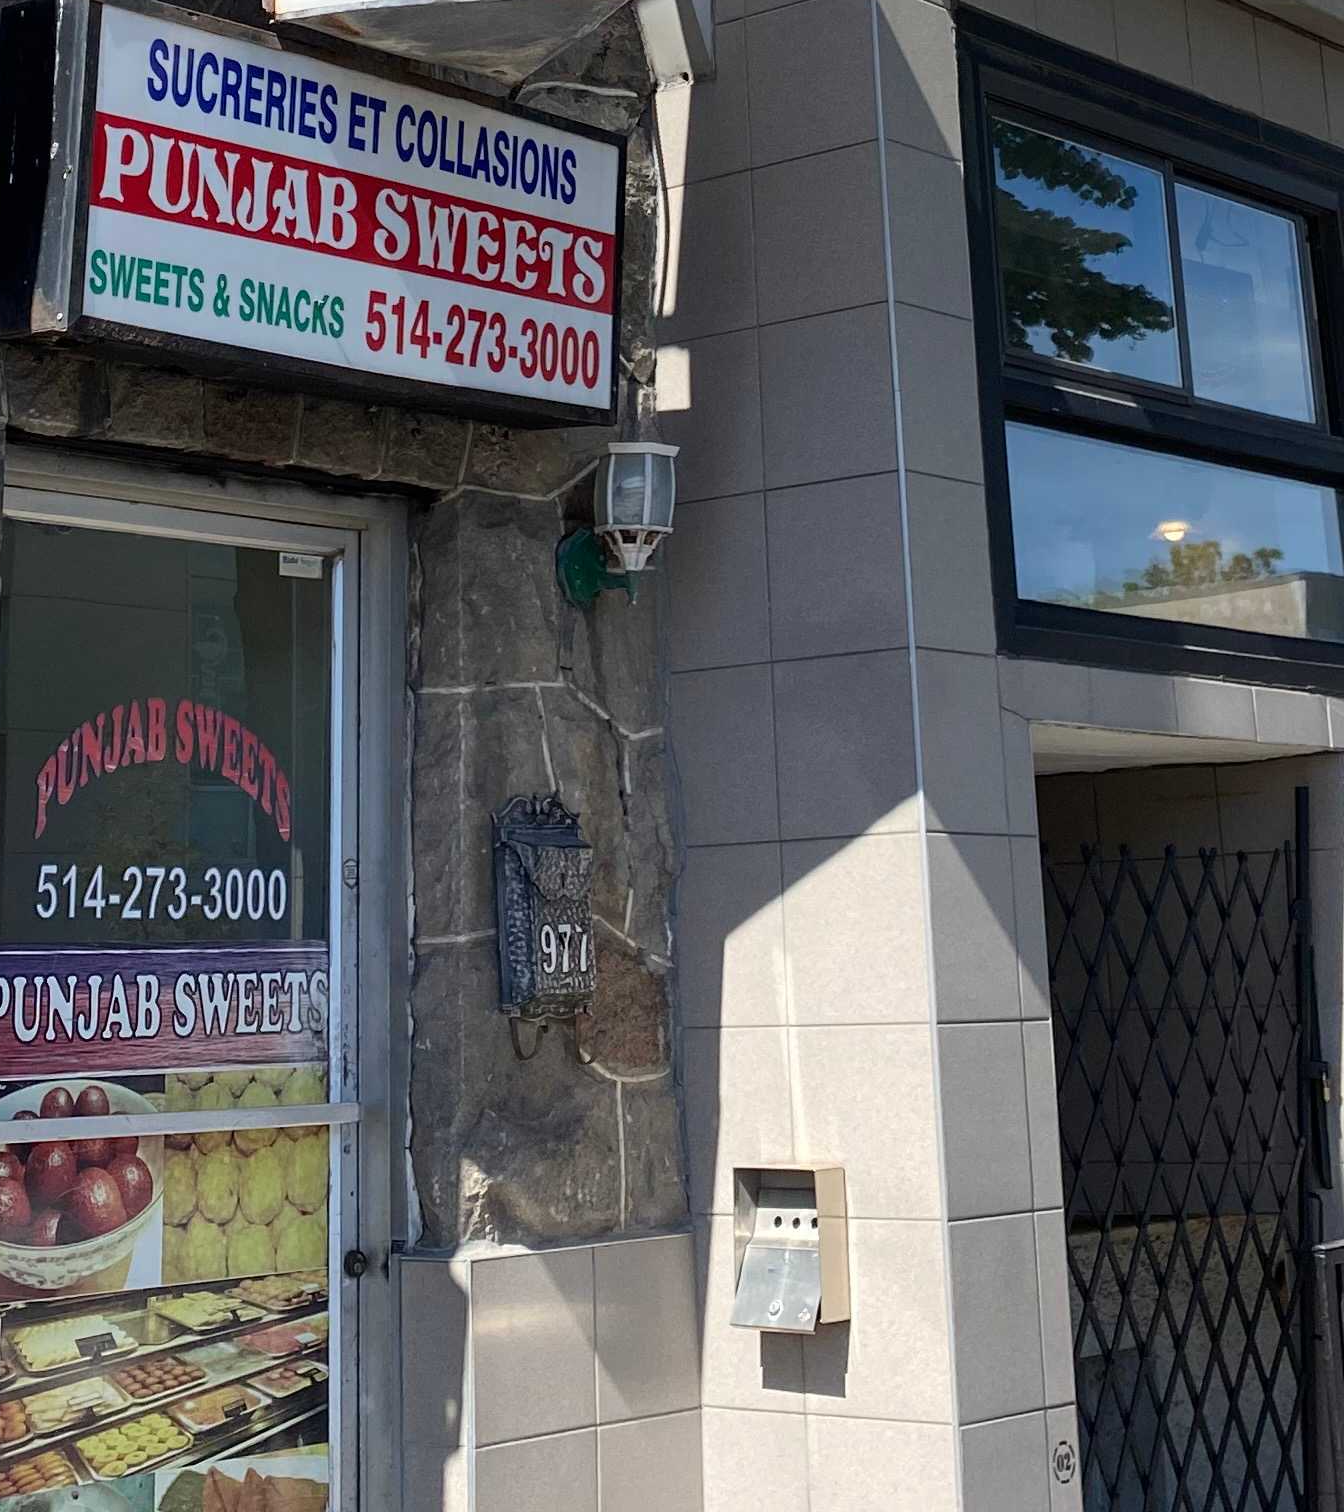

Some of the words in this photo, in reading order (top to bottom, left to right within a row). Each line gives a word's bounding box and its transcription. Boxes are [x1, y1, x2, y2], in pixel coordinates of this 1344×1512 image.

[146, 38, 337, 144] SUCRERIES
[348, 91, 387, 154] ET
[396, 103, 577, 205] COLLASIONS
[98, 124, 357, 251] PUNJAB
[373, 192, 606, 303] SWEETS
[89, 249, 203, 312] SWEETS
[212, 273, 230, 318] &
[239, 278, 345, 338] SNACKS
[365, 290, 600, 388] 514-273-3000
[34, 697, 167, 840] PUNJAB
[175, 698, 293, 842] SWEETS
[36, 865, 287, 921] 514-273-3000
[172, 970, 328, 1038] SWEETS
